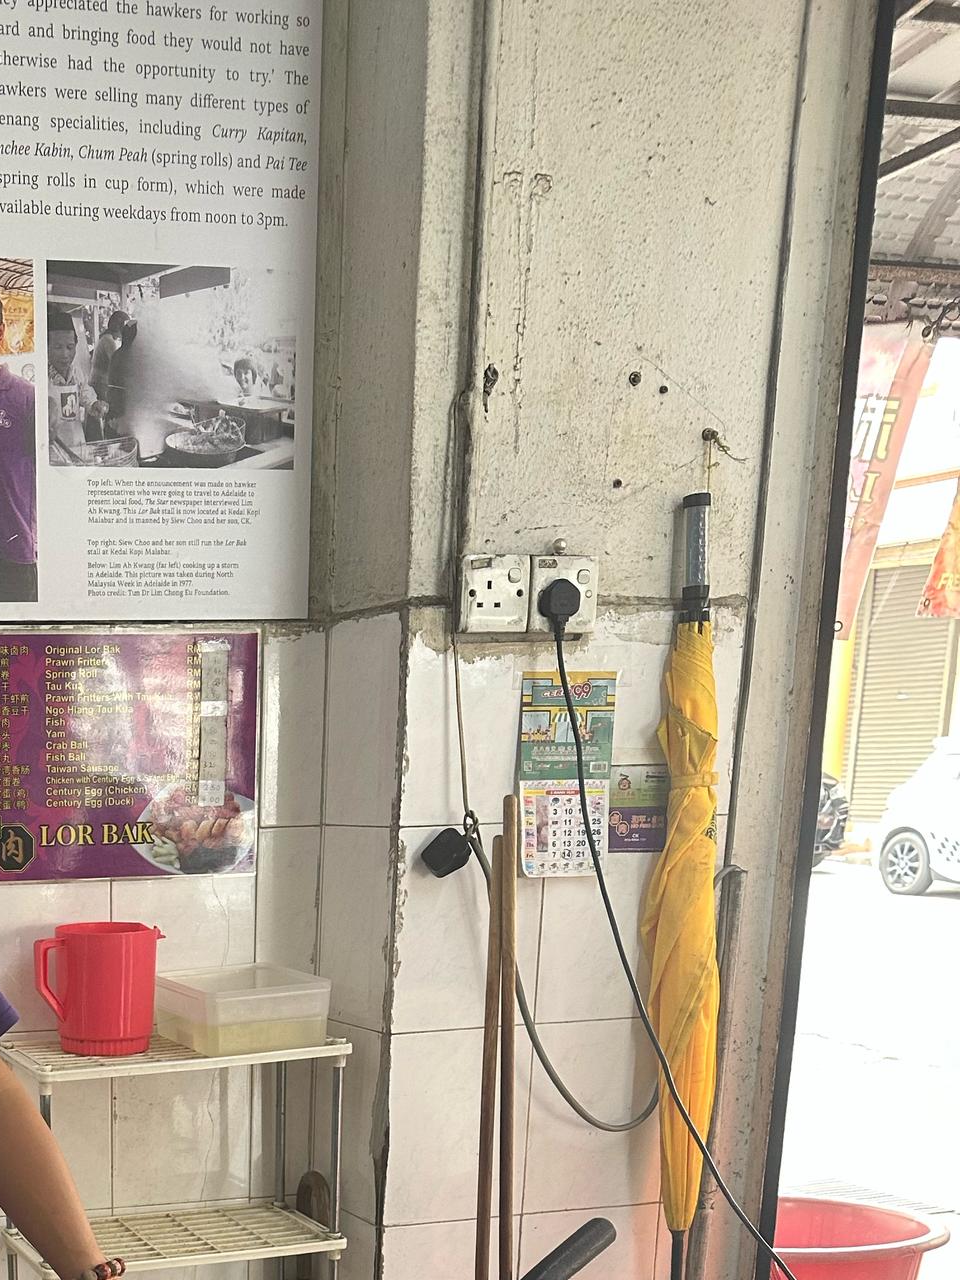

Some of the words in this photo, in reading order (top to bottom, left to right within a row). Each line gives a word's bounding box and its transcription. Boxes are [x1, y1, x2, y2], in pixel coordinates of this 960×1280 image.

[33, 142, 73, 161] Kabin,
[79, 144, 115, 161] Chum
[118, 147, 148, 163] Peah
[152, 148, 197, 170] (spring
[200, 151, 232, 170] rolls)
[237, 154, 261, 169] and
[265, 155, 285, 170] Pai
[289, 157, 307, 171] Tee
[47, 172, 75, 187] rolls
[84, 174, 96, 188] in
[105, 179, 129, 194] cup
[137, 176, 176, 196] form),
[185, 179, 224, 195] which
[232, 186, 263, 197] were
[272, 185, 305, 200] made
[55, 201, 99, 222] during
[103, 204, 166, 224] weekdays
[170, 206, 201, 222] from
[205, 212, 236, 224] noon
[241, 212, 254, 227] to
[255, 212, 288, 230] 3pm.
[40, 824, 93, 847] LOR
[102, 822, 155, 844] BAK
